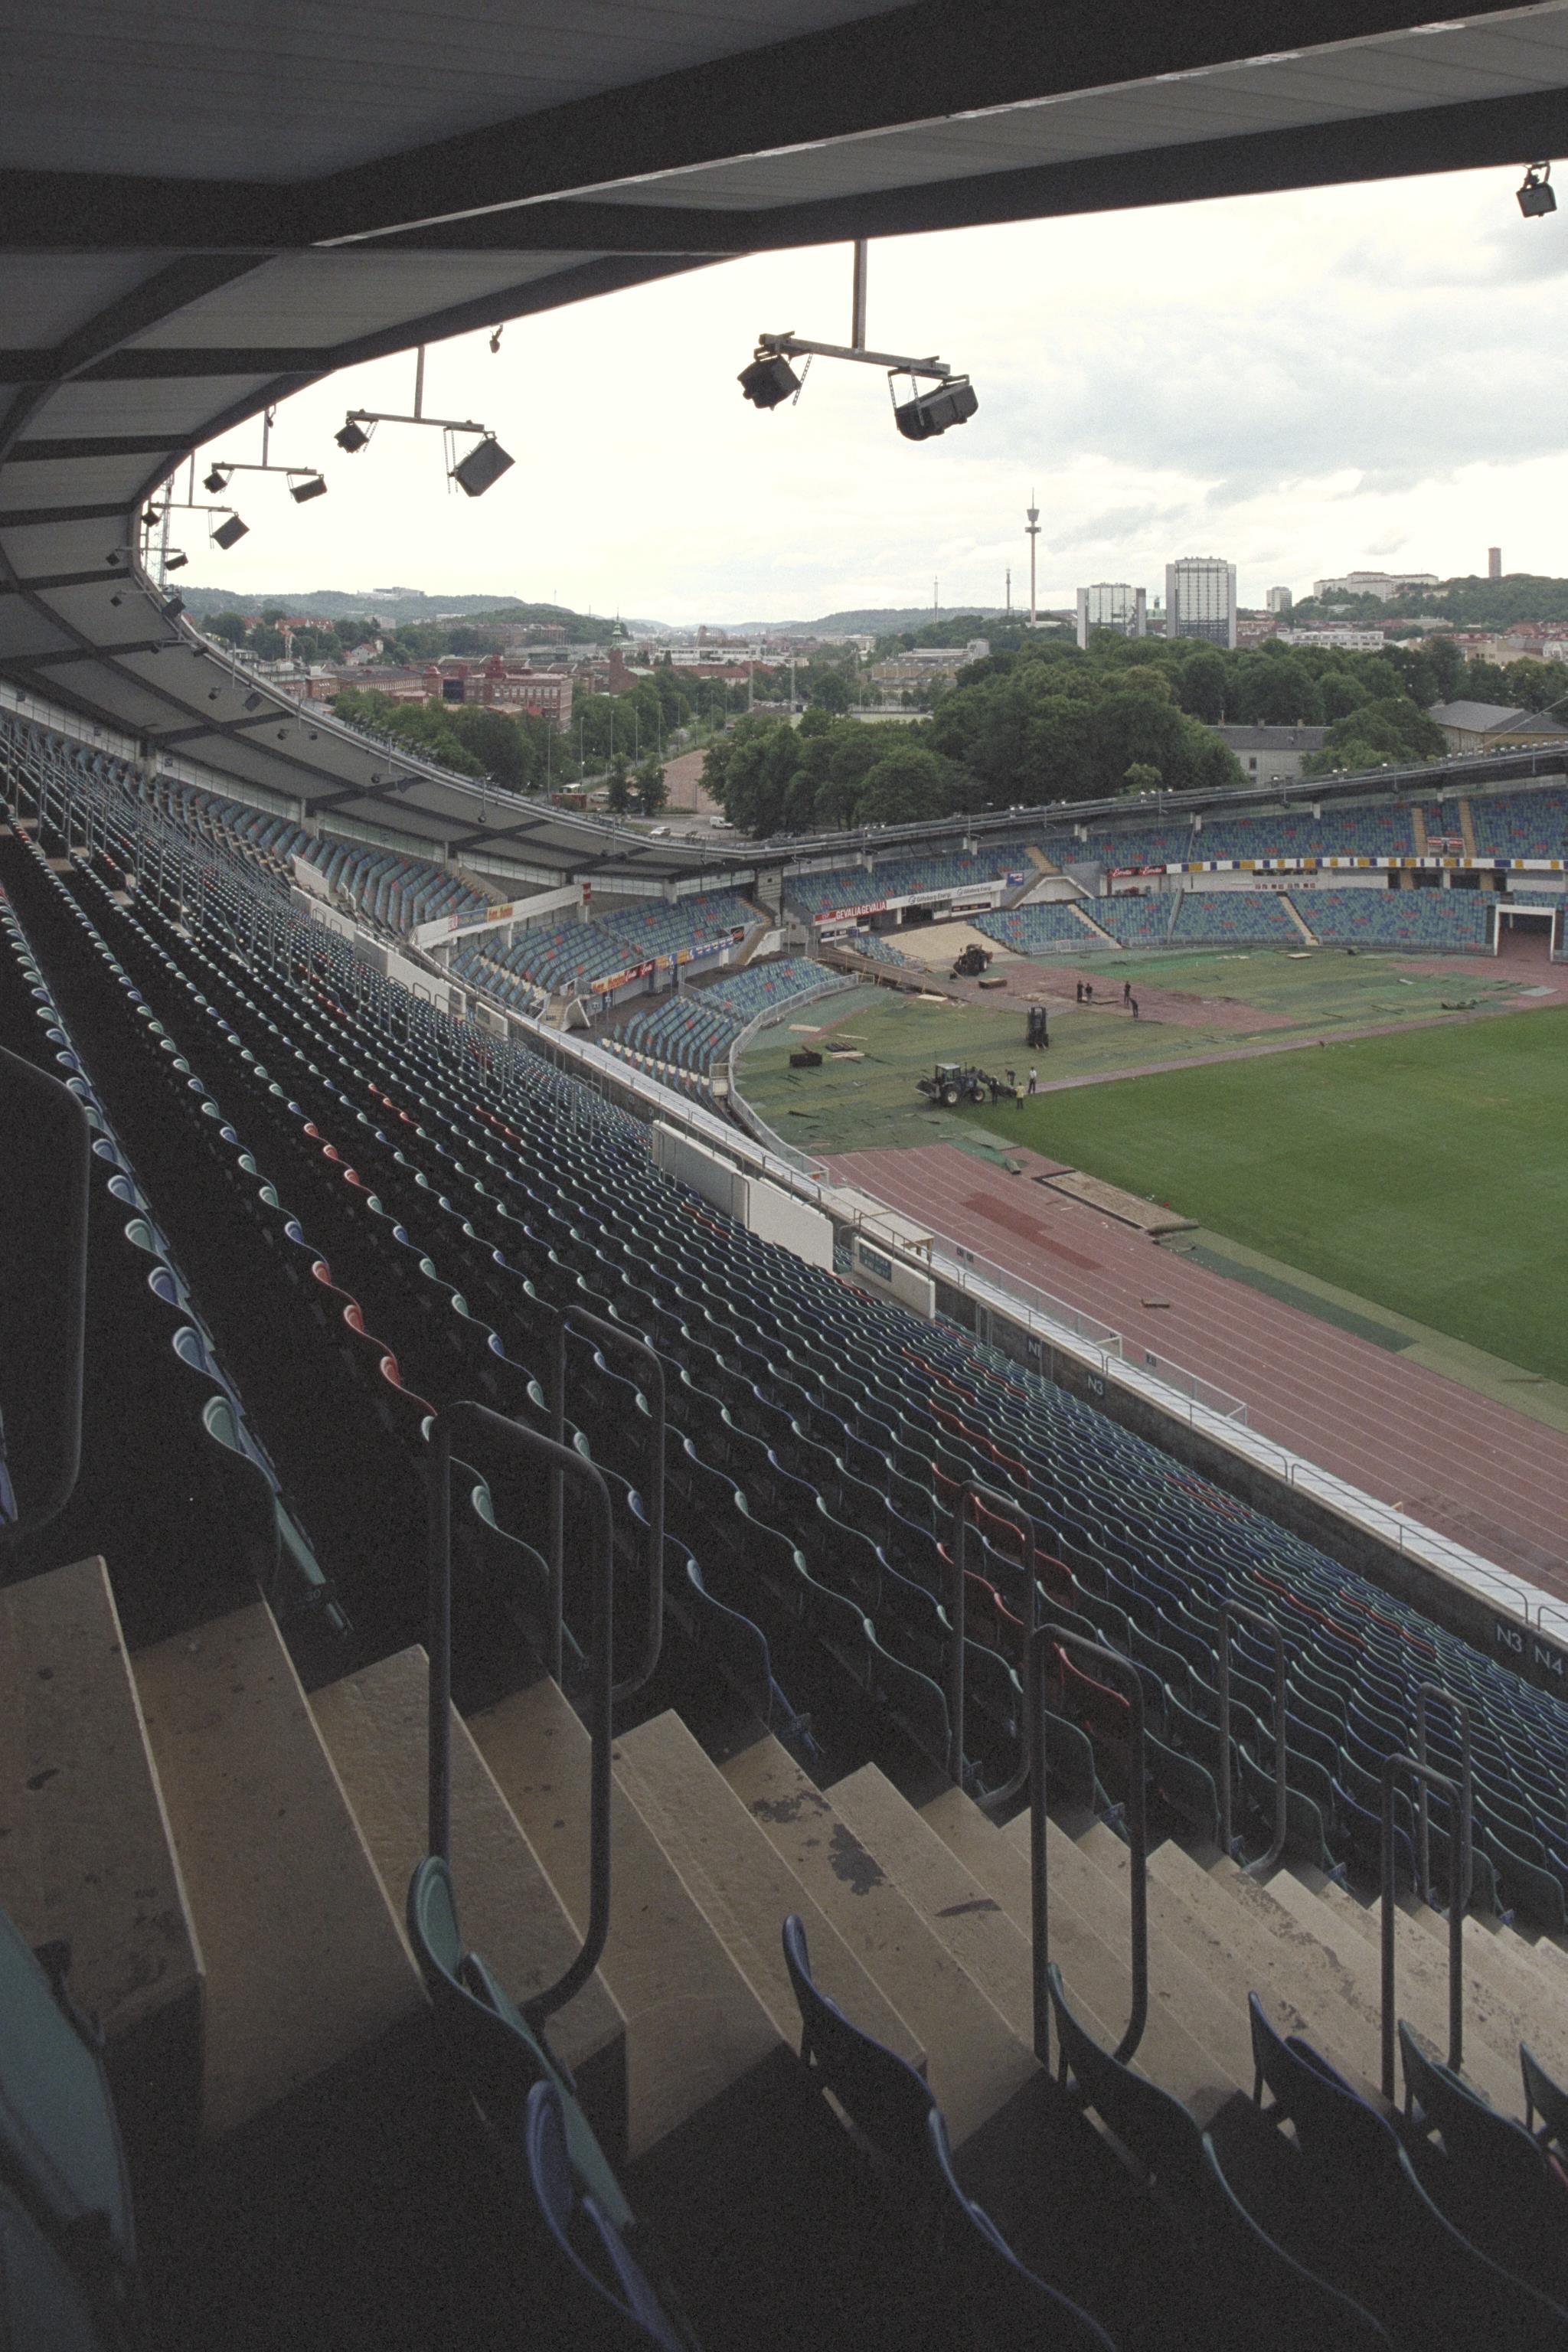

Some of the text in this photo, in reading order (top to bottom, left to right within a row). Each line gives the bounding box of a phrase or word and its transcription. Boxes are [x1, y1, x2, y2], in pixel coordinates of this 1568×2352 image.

[861, 900, 886, 915] GEVALIA
[916, 894, 937, 903] Göteborg
[836, 906, 861, 920] GEVALIA
[1087, 1375, 1103, 1396] N3
[1497, 1624, 1522, 1652] N3
[1534, 1645, 1563, 1675] N4
